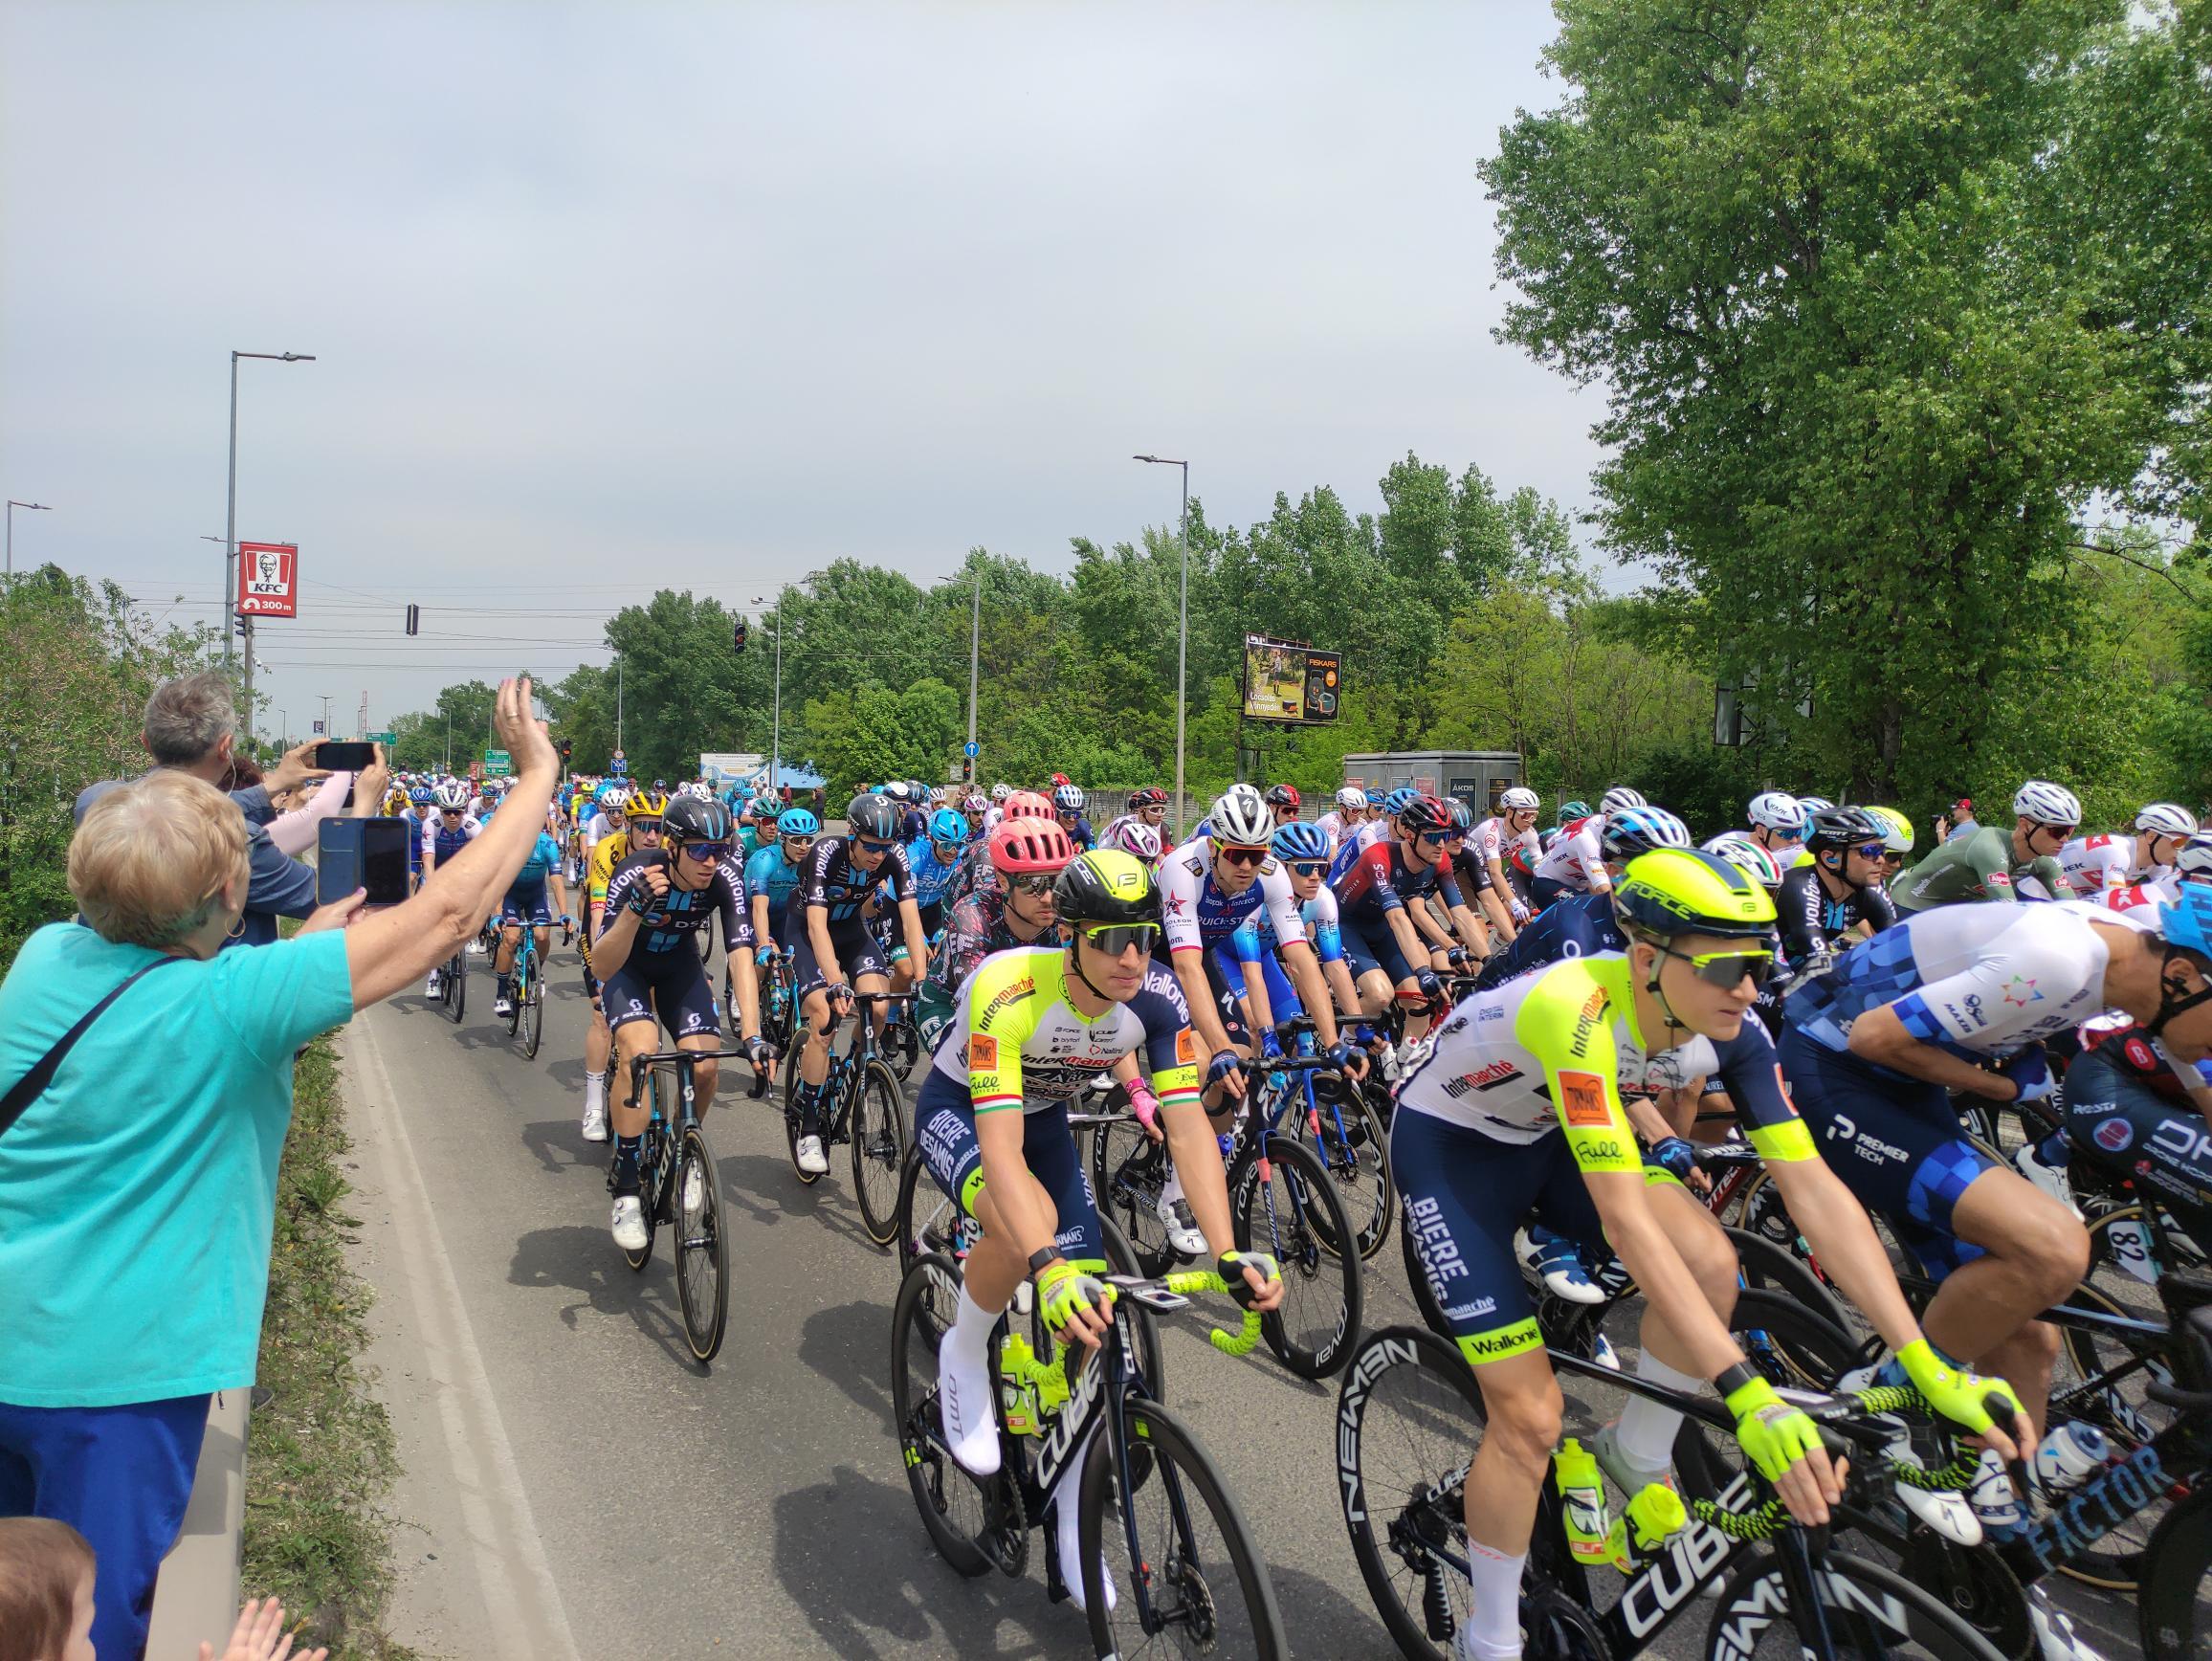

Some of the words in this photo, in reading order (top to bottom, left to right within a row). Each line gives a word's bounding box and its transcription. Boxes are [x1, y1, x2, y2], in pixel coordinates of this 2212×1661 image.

[254, 583, 282, 593] KFC
[262, 601, 282, 610] 300
[1309, 658, 1338, 668] FISKARS
[1552, 853, 1570, 864] TREK
[1372, 863, 1393, 896] INEOS
[1626, 881, 1699, 920] FORCE
[675, 919, 699, 928] DS
[1756, 991, 1776, 1007] SM
[679, 1026, 712, 1036] SCOTT
[1020, 1053, 1124, 1067] Intermarch
[1576, 1141, 1624, 1164] Full
[1854, 1143, 1885, 1165] TECH
[1856, 1132, 1910, 1163] PREMIER
[1413, 1196, 1470, 1282] BIERE
[2111, 1231, 2146, 1262] 82
[1115, 1312, 1136, 1374] CUBE
[1471, 1325, 1539, 1357] Wallonie
[1037, 1349, 1101, 1490] CUBE
[1427, 1461, 1471, 1503] CUBE
[2027, 1445, 2178, 1572] FACTOR
[1621, 1471, 1754, 1639] CUBE
